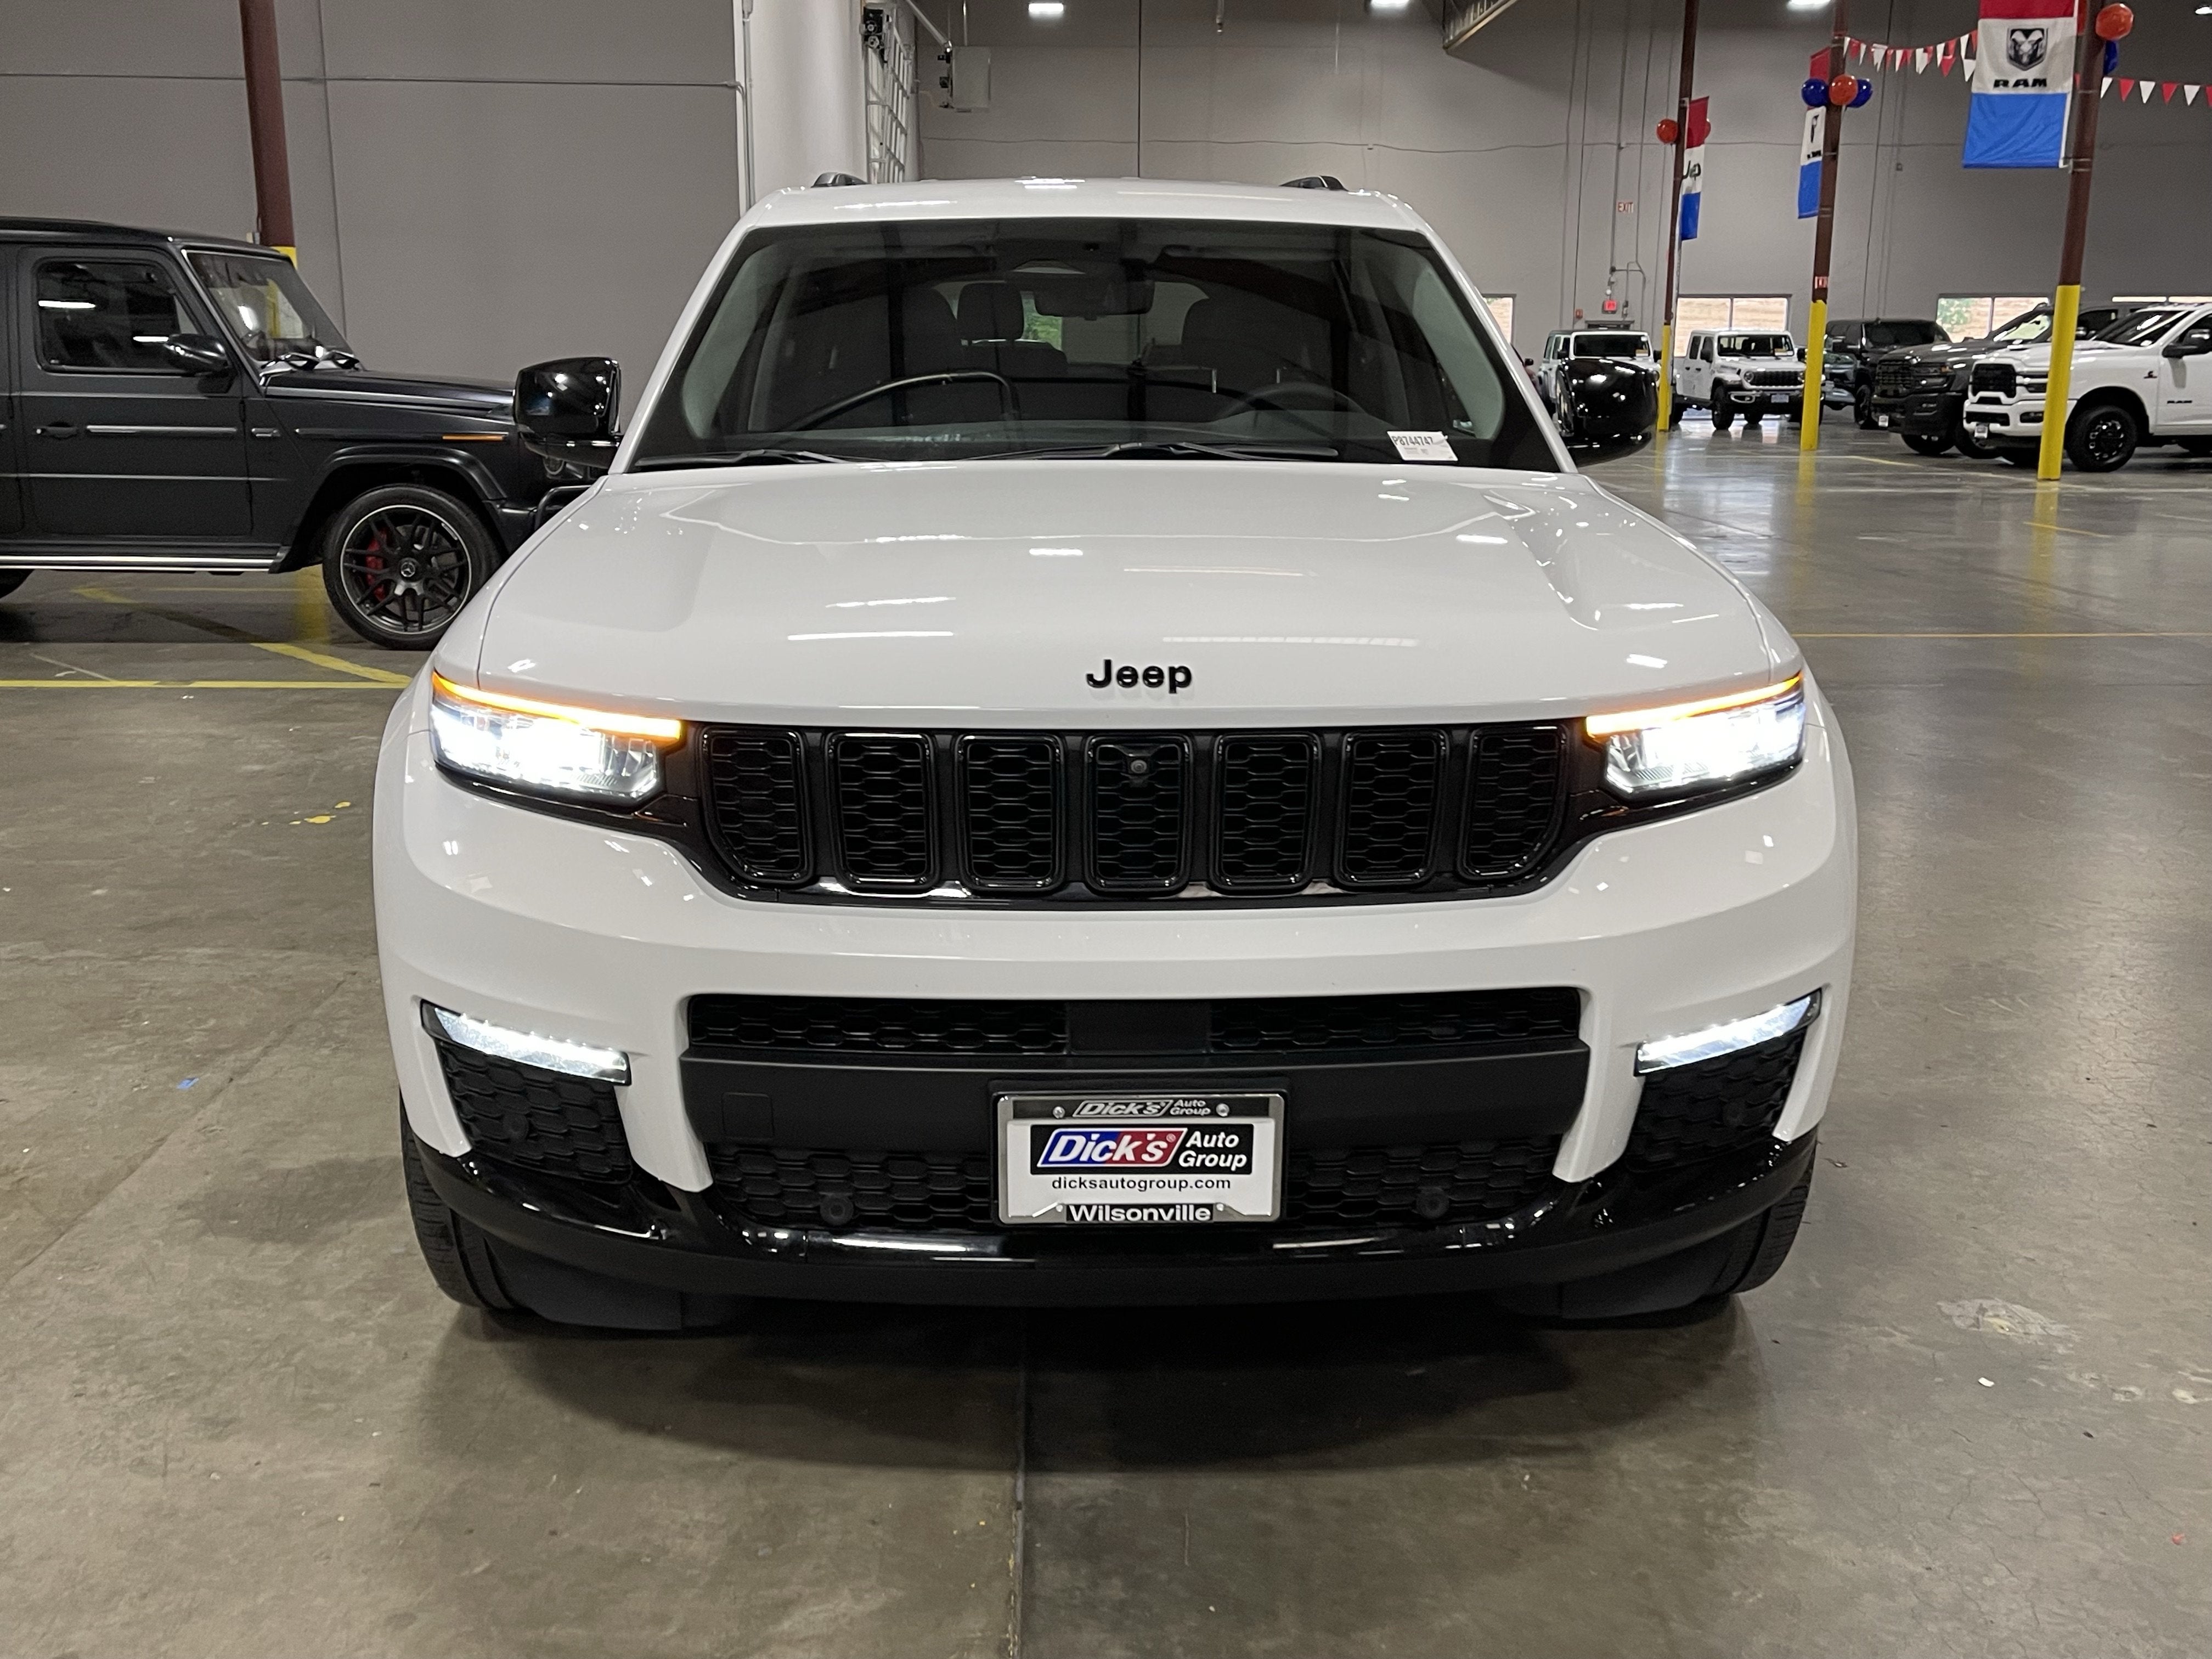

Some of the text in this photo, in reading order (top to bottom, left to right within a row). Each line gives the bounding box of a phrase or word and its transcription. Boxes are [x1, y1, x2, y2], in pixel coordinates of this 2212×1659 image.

[1994, 78, 2047, 88] RAM
[1618, 201, 1633, 212] EXIT
[1086, 659, 1192, 694] Jeep
[1174, 1099, 1206, 1107] Auto
[1170, 1107, 1211, 1116] Group
[1048, 1133, 1169, 1162] Dick's
[1185, 1131, 1240, 1148] Auto
[1178, 1150, 1248, 1171] Group
[1052, 1177, 1231, 1192] dicksautogroup.com
[1069, 1204, 1211, 1222] Wilsonville
